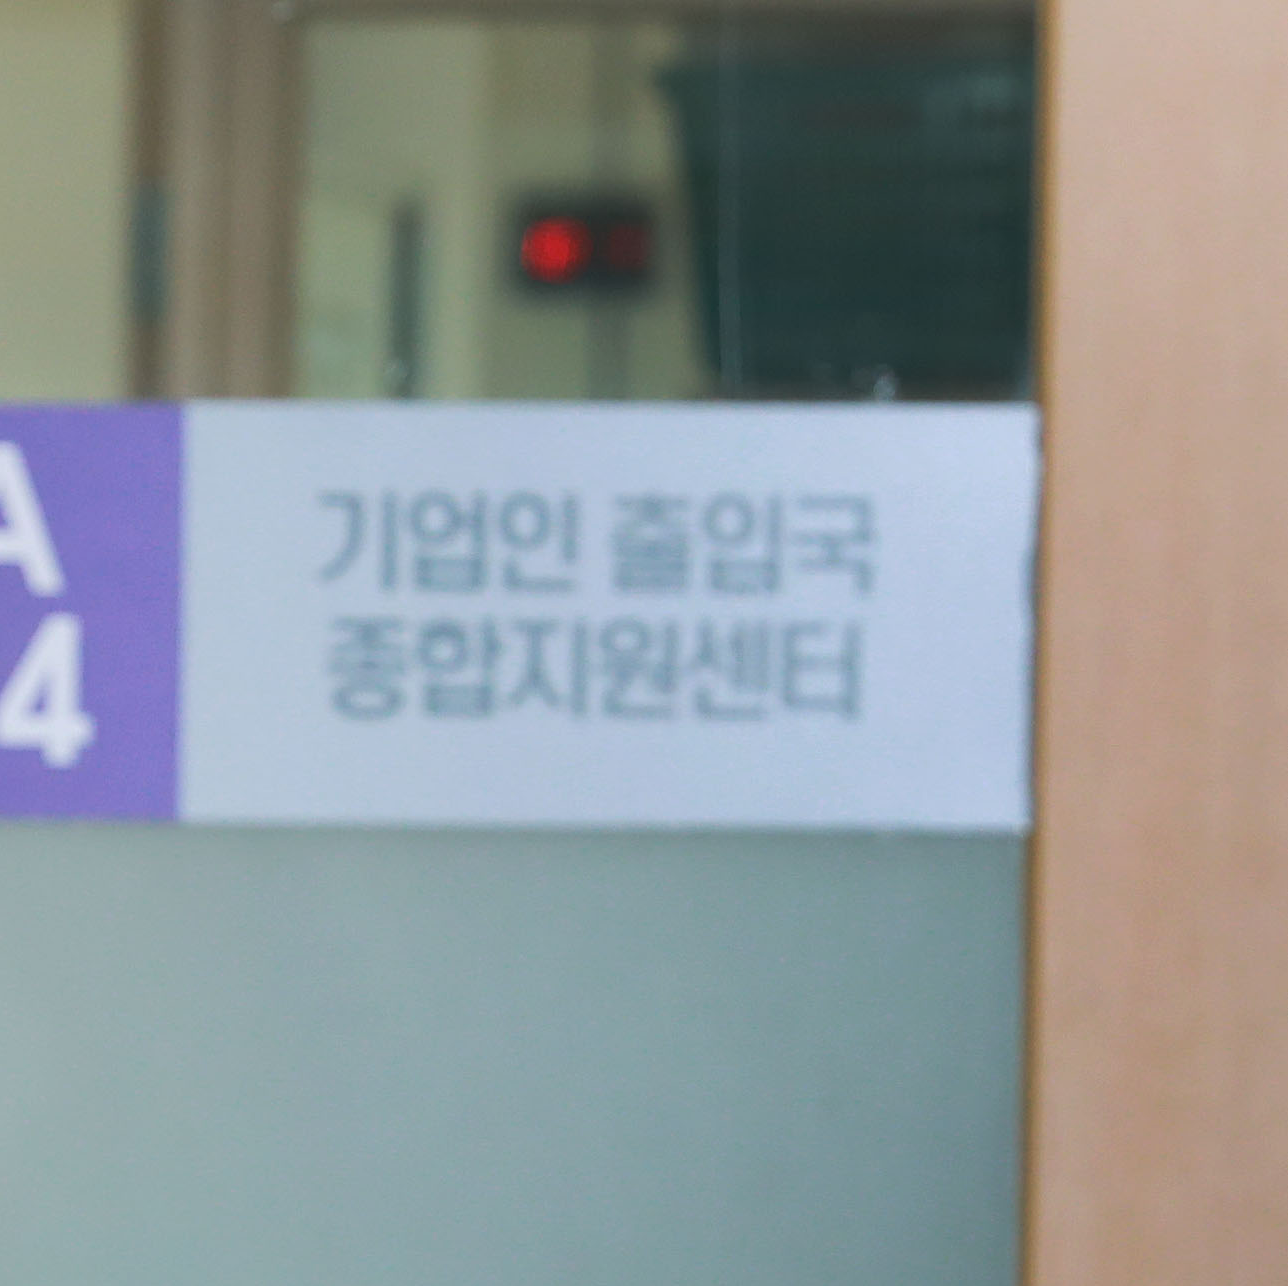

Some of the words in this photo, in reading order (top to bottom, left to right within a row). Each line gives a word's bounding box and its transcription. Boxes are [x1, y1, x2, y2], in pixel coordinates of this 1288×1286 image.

[317, 491, 581, 592] 기업인
[610, 491, 876, 594] 출입국
[325, 617, 864, 720] 종합지원센터
